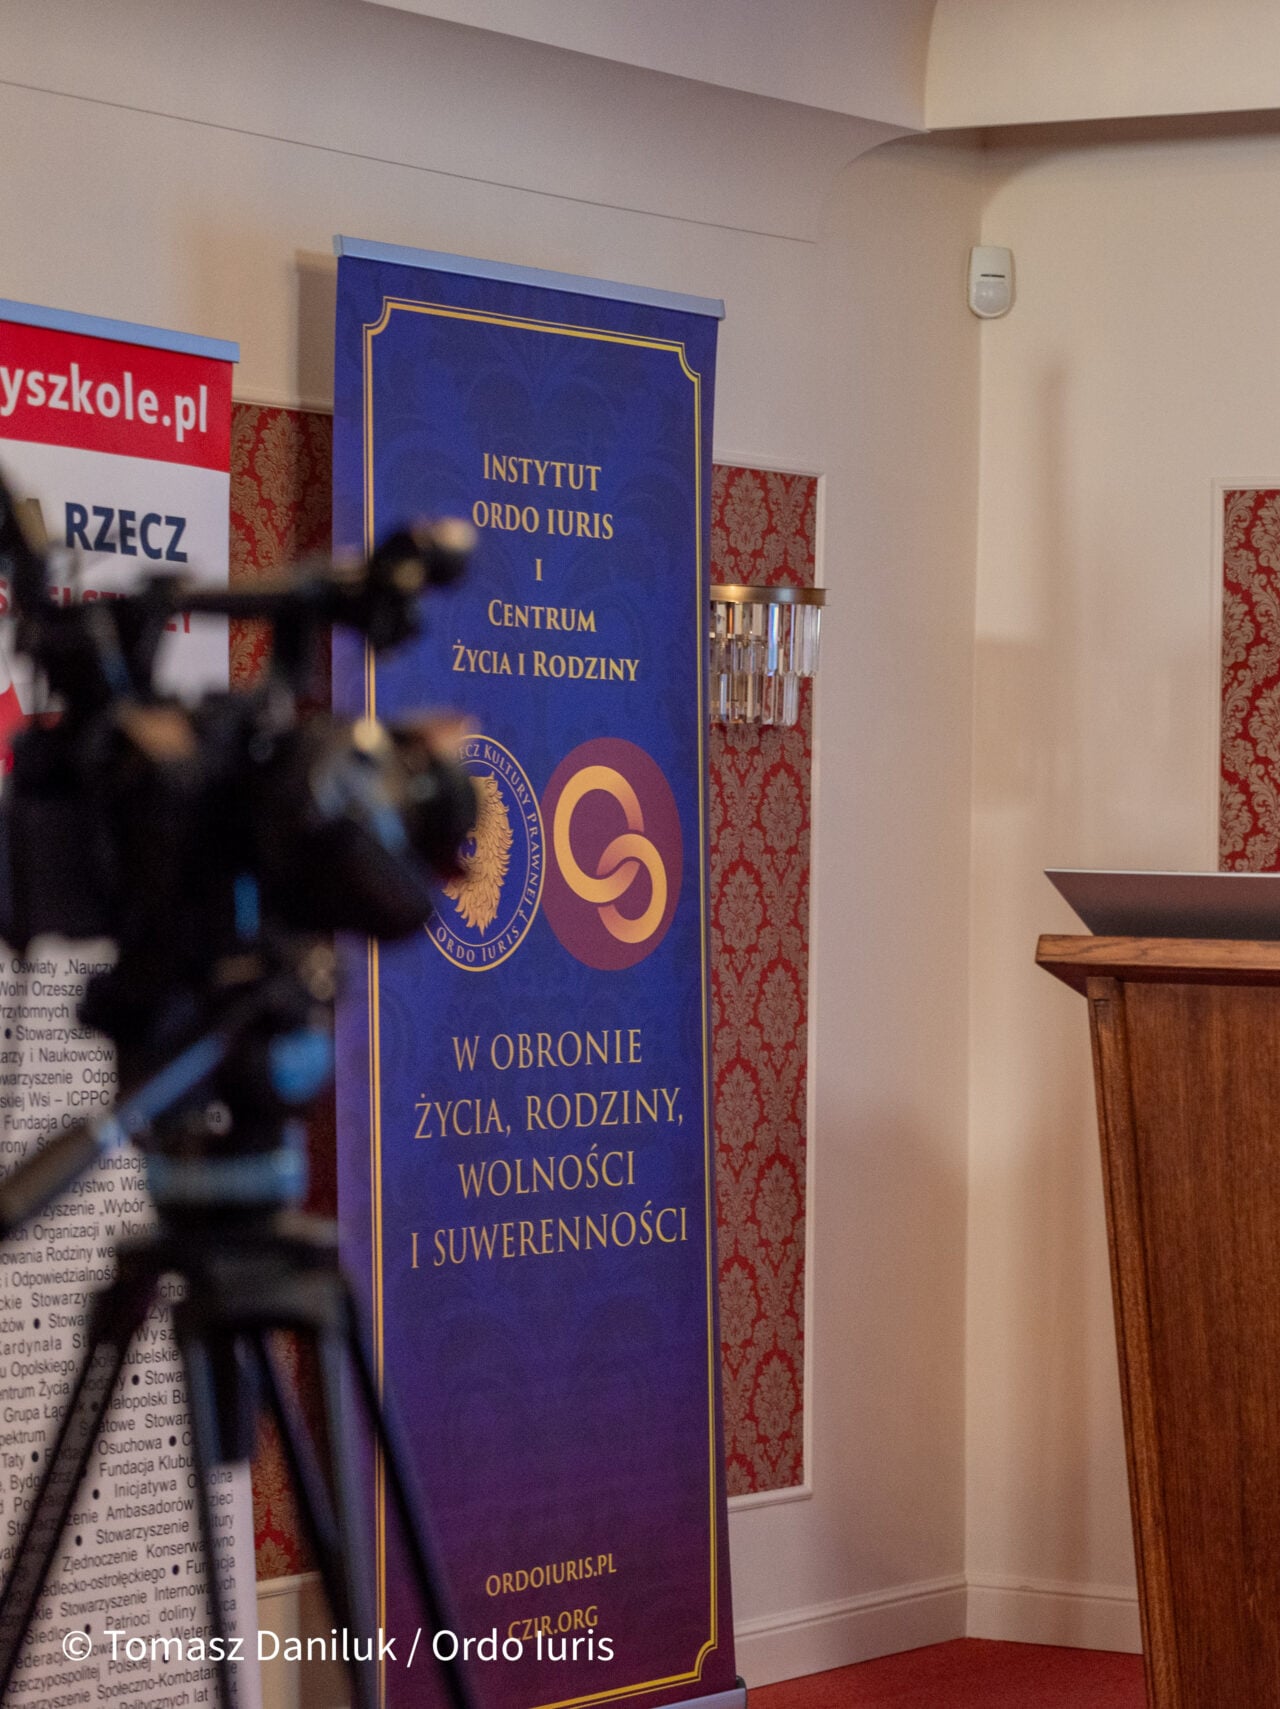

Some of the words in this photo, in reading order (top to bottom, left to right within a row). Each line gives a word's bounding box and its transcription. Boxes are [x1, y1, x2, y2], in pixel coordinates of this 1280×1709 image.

[0, 362, 208, 442] yszkole.pl
[483, 452, 602, 491] INSTYTUT
[65, 502, 188, 563] RZECZ
[472, 500, 540, 533] ORDO
[547, 508, 614, 540] IURIS
[535, 558, 543, 581] I
[484, 744, 531, 805] KULTURY
[526, 812, 541, 906] PRAWNEJ
[436, 936, 476, 963] ORDO
[481, 926, 520, 962] IURIS
[453, 1035, 480, 1072] W
[490, 1029, 642, 1070] OBRONIE
[66, 1090, 110, 1106] ICPPC
[414, 1093, 511, 1138] ŻYCIA,
[526, 1087, 683, 1126] RODZINY,
[458, 1143, 635, 1199] WOLNOŚCI
[411, 1232, 419, 1268] I
[433, 1200, 688, 1267] SUWERENNOŚCI
[485, 1552, 617, 1597] ORDOIURIS.PL
[507, 1605, 600, 1641] CZIR.ORG
